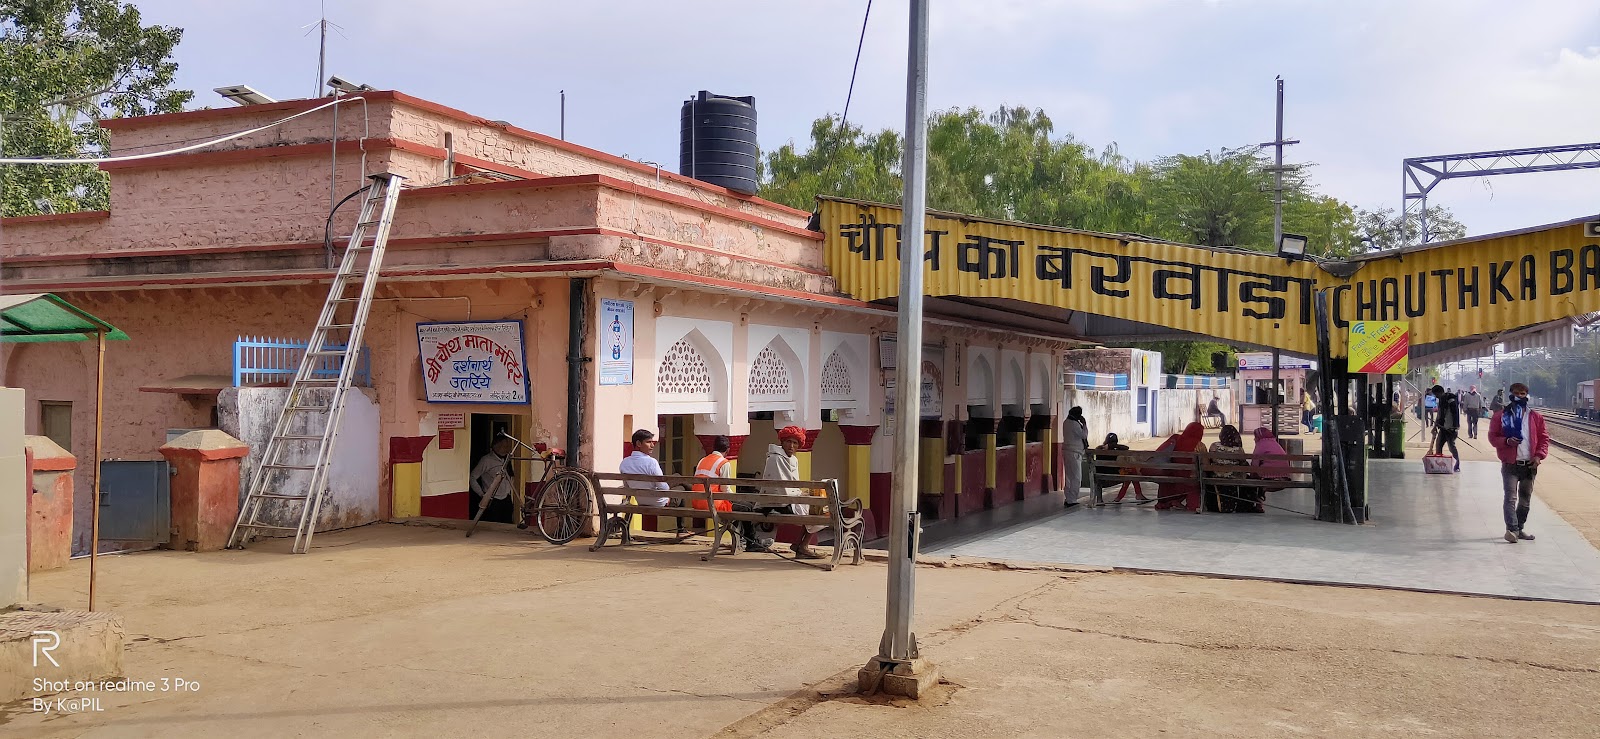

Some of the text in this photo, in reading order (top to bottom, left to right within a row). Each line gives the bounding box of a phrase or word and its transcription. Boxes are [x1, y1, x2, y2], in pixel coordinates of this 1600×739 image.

[957, 234, 1025, 280] का
[1332, 266, 1479, 329] CHAUTH
[1489, 254, 1537, 304] KA
[1370, 323, 1391, 340] Free
[1377, 325, 1401, 344] Wi-Fi
[426, 334, 524, 385] श्री चौथ माता मंदिर
[452, 355, 493, 373] दर्शनार्थ
[512, 390, 517, 400] 2
